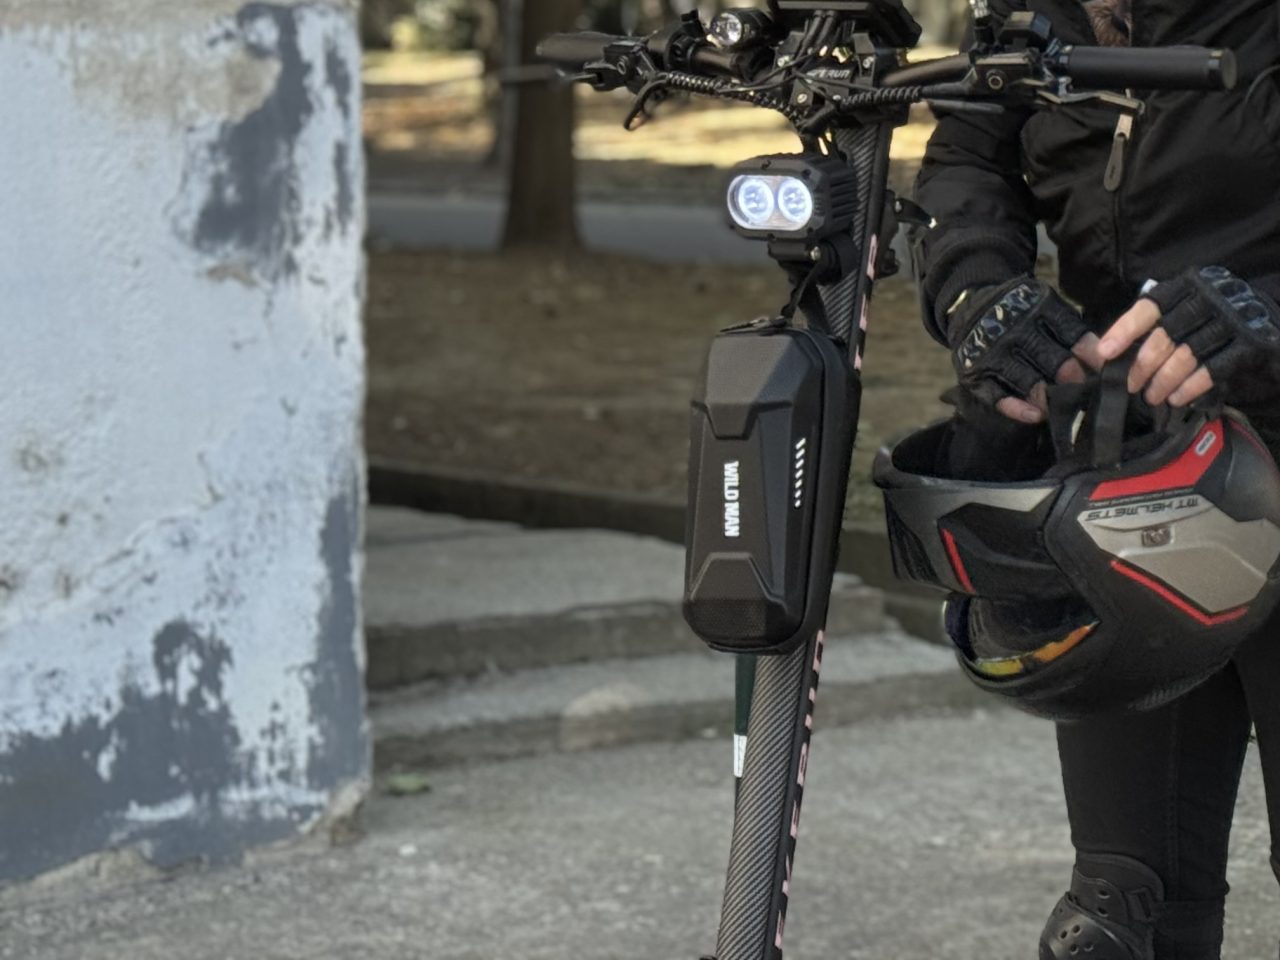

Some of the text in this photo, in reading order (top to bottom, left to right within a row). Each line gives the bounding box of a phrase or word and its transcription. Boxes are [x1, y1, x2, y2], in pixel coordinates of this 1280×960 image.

[724, 460, 740, 537] WILD MAN
[1175, 497, 1200, 510] MT
[1085, 500, 1174, 522] HELMETS
